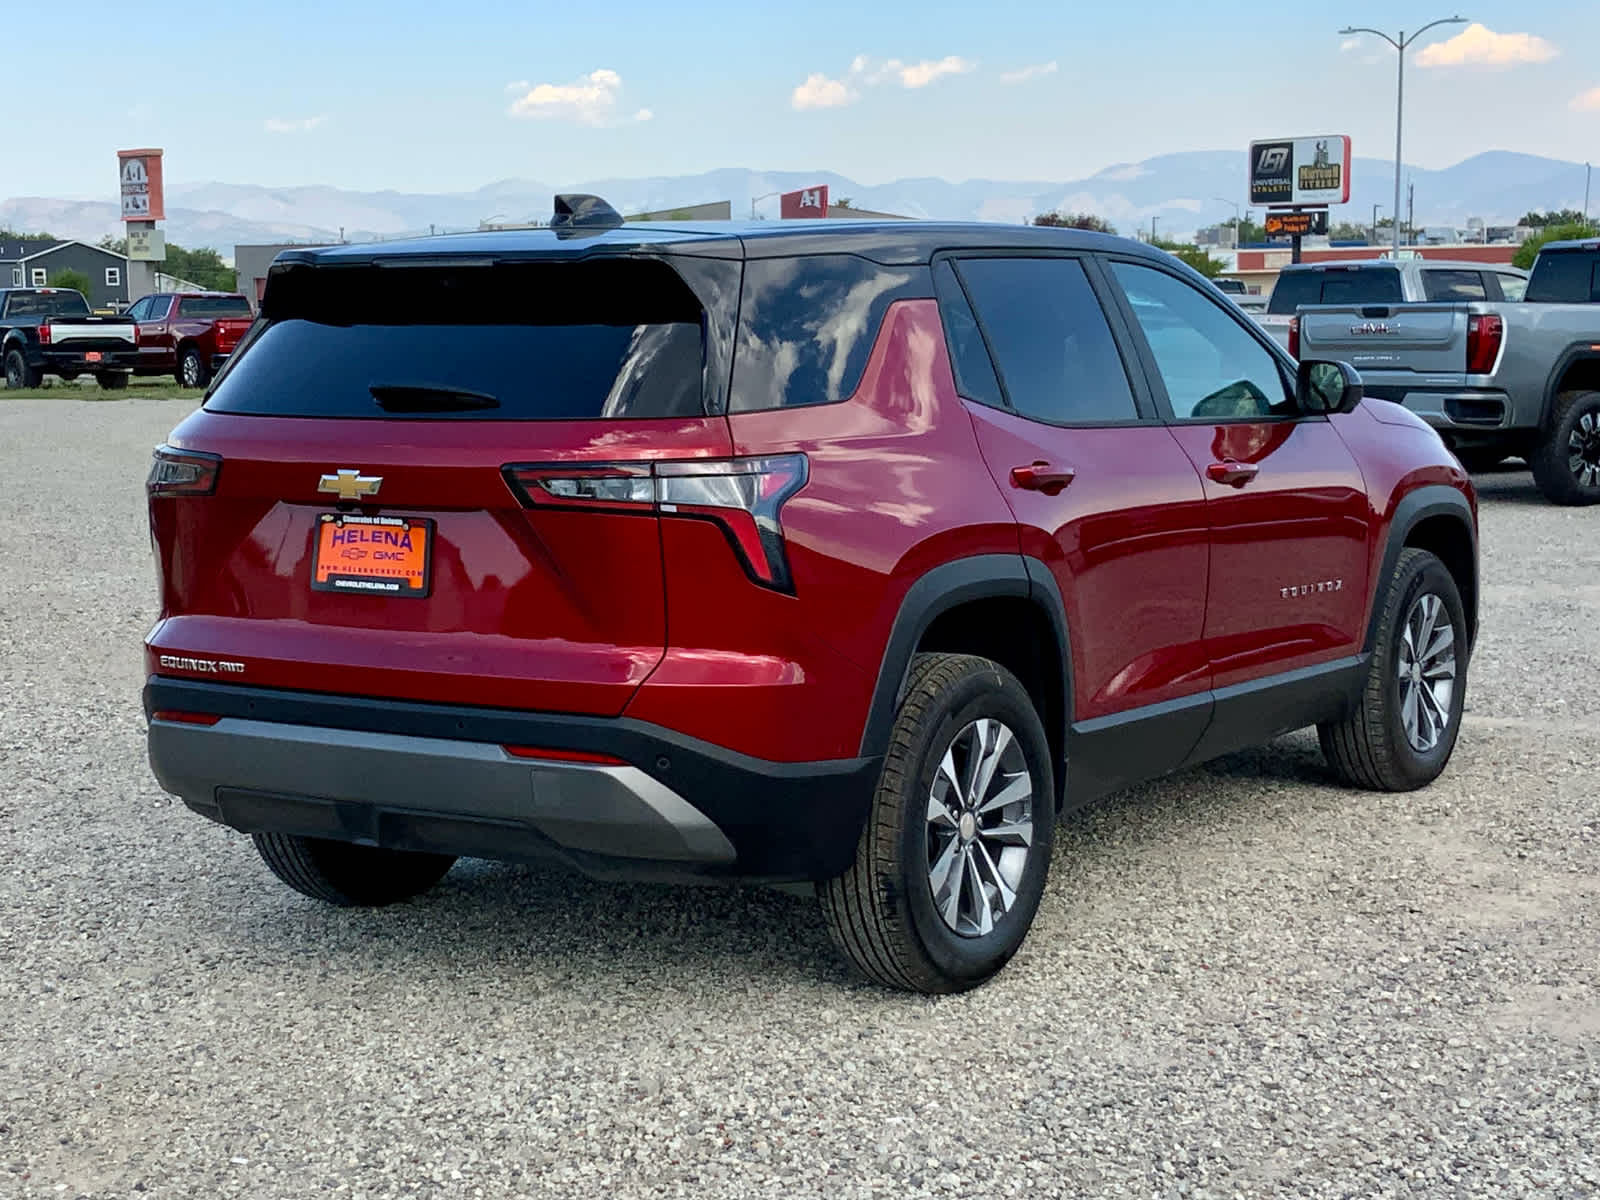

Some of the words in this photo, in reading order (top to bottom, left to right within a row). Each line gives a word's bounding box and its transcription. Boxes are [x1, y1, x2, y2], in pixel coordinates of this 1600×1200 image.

[331, 529, 413, 553] HELENA
[373, 551, 405, 562] GMC
[1279, 579, 1343, 599] EQUINOX
[159, 654, 218, 673] EQUINOX
